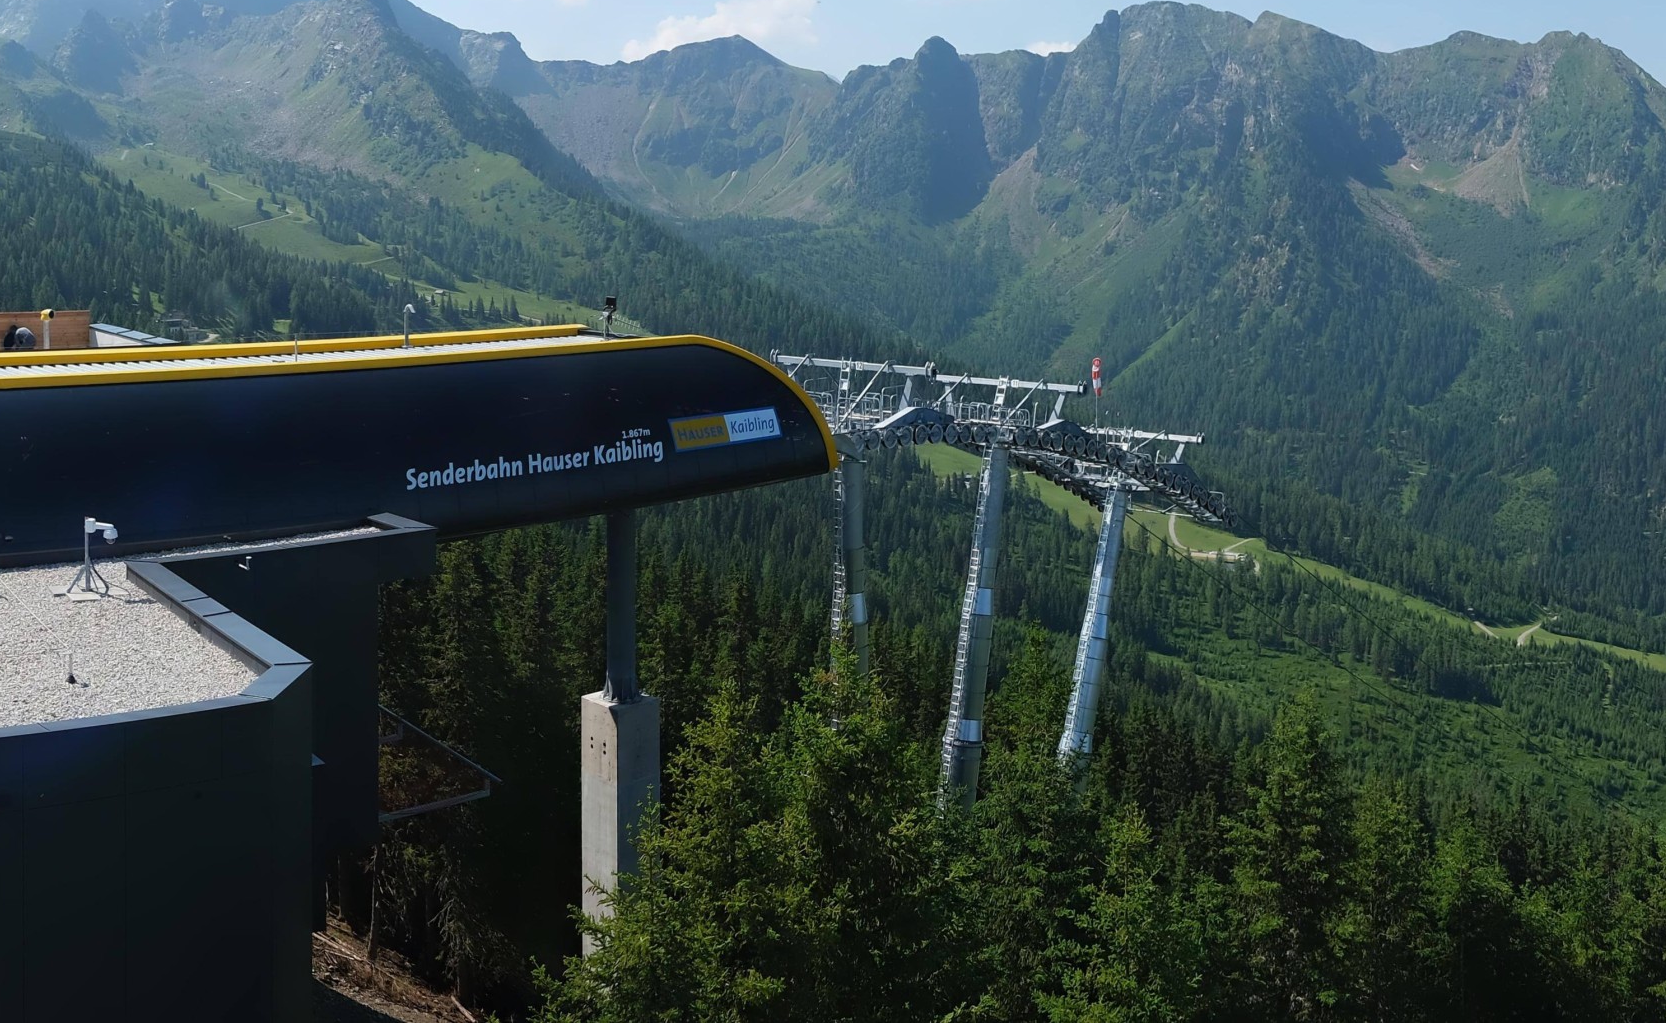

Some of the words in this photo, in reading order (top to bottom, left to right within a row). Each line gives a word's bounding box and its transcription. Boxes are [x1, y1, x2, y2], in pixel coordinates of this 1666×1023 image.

[622, 428, 651, 439] 1.867m
[677, 425, 724, 441] HAUSER
[731, 416, 775, 434] Kaibling
[406, 456, 523, 490] Senderbahn
[528, 451, 590, 474] Hauser
[594, 438, 664, 464] Kaibling
